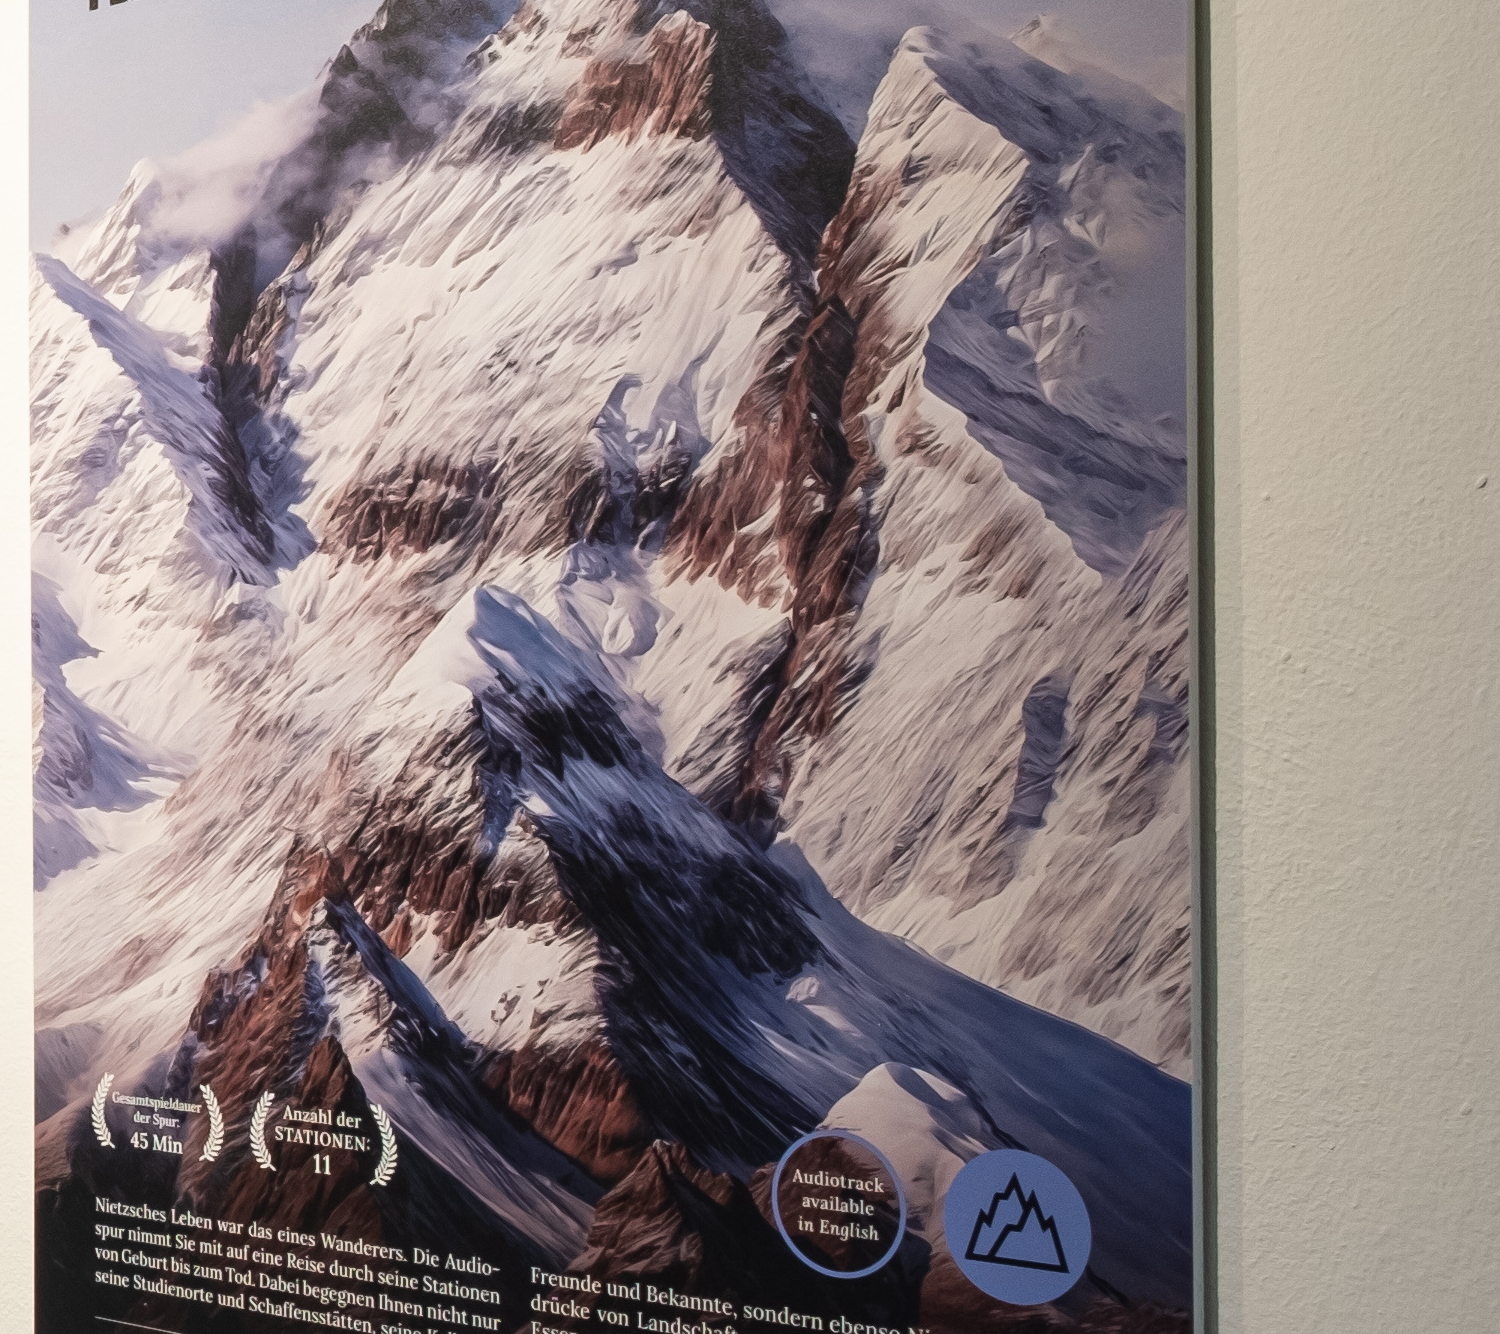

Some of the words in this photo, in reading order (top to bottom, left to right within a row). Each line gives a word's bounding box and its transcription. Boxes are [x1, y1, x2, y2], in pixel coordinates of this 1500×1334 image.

[111, 1091, 203, 1114] Gesamtspieldauer
[132, 1110, 152, 1124] der
[151, 1112, 181, 1130] Spur:
[282, 1104, 333, 1126] Anzahl
[335, 1110, 362, 1129] der
[129, 1130, 149, 1150] 45
[151, 1133, 184, 1155] Min
[273, 1125, 371, 1153] STATIONEN:
[312, 1152, 332, 1176] 11
[792, 1167, 884, 1194] Audiotrack
[801, 1195, 874, 1217] available
[94, 1195, 167, 1223] Nietzsches
[170, 1207, 213, 1231] Leben
[216, 1219, 244, 1235] war
[247, 1220, 273, 1241] das
[276, 1225, 316, 1248] eines
[319, 1231, 408, 1263] Wanderers.
[412, 1246, 440, 1268] Die
[443, 1252, 501, 1277] Audio-
[797, 1215, 815, 1233] in
[818, 1218, 880, 1242] English
[93, 1223, 126, 1240] spur
[127, 1226, 172, 1248] nimmt
[174, 1232, 196, 1252] Sie
[198, 1238, 224, 1257] mit
[225, 1243, 251, 1261] auf
[251, 1246, 283, 1267] eine
[286, 1251, 326, 1274] Reise
[328, 1258, 374, 1283] durch
[377, 1269, 419, 1291] seine
[422, 1274, 501, 1306] Stationen
[93, 1246, 119, 1263] von
[120, 1247, 169, 1272] Geburt
[169, 1255, 191, 1275] bis
[192, 1264, 223, 1282] zum
[224, 1265, 256, 1288] Tod.
[258, 1271, 300, 1295] Dabei
[301, 1278, 376, 1309] begegnen
[378, 1292, 424, 1318] Ihnen
[426, 1303, 469, 1326] nicht
[471, 1313, 502, 1331] nur
[94, 1268, 130, 1288] seine
[132, 1273, 214, 1304] Studienorte
[216, 1292, 245, 1310] und
